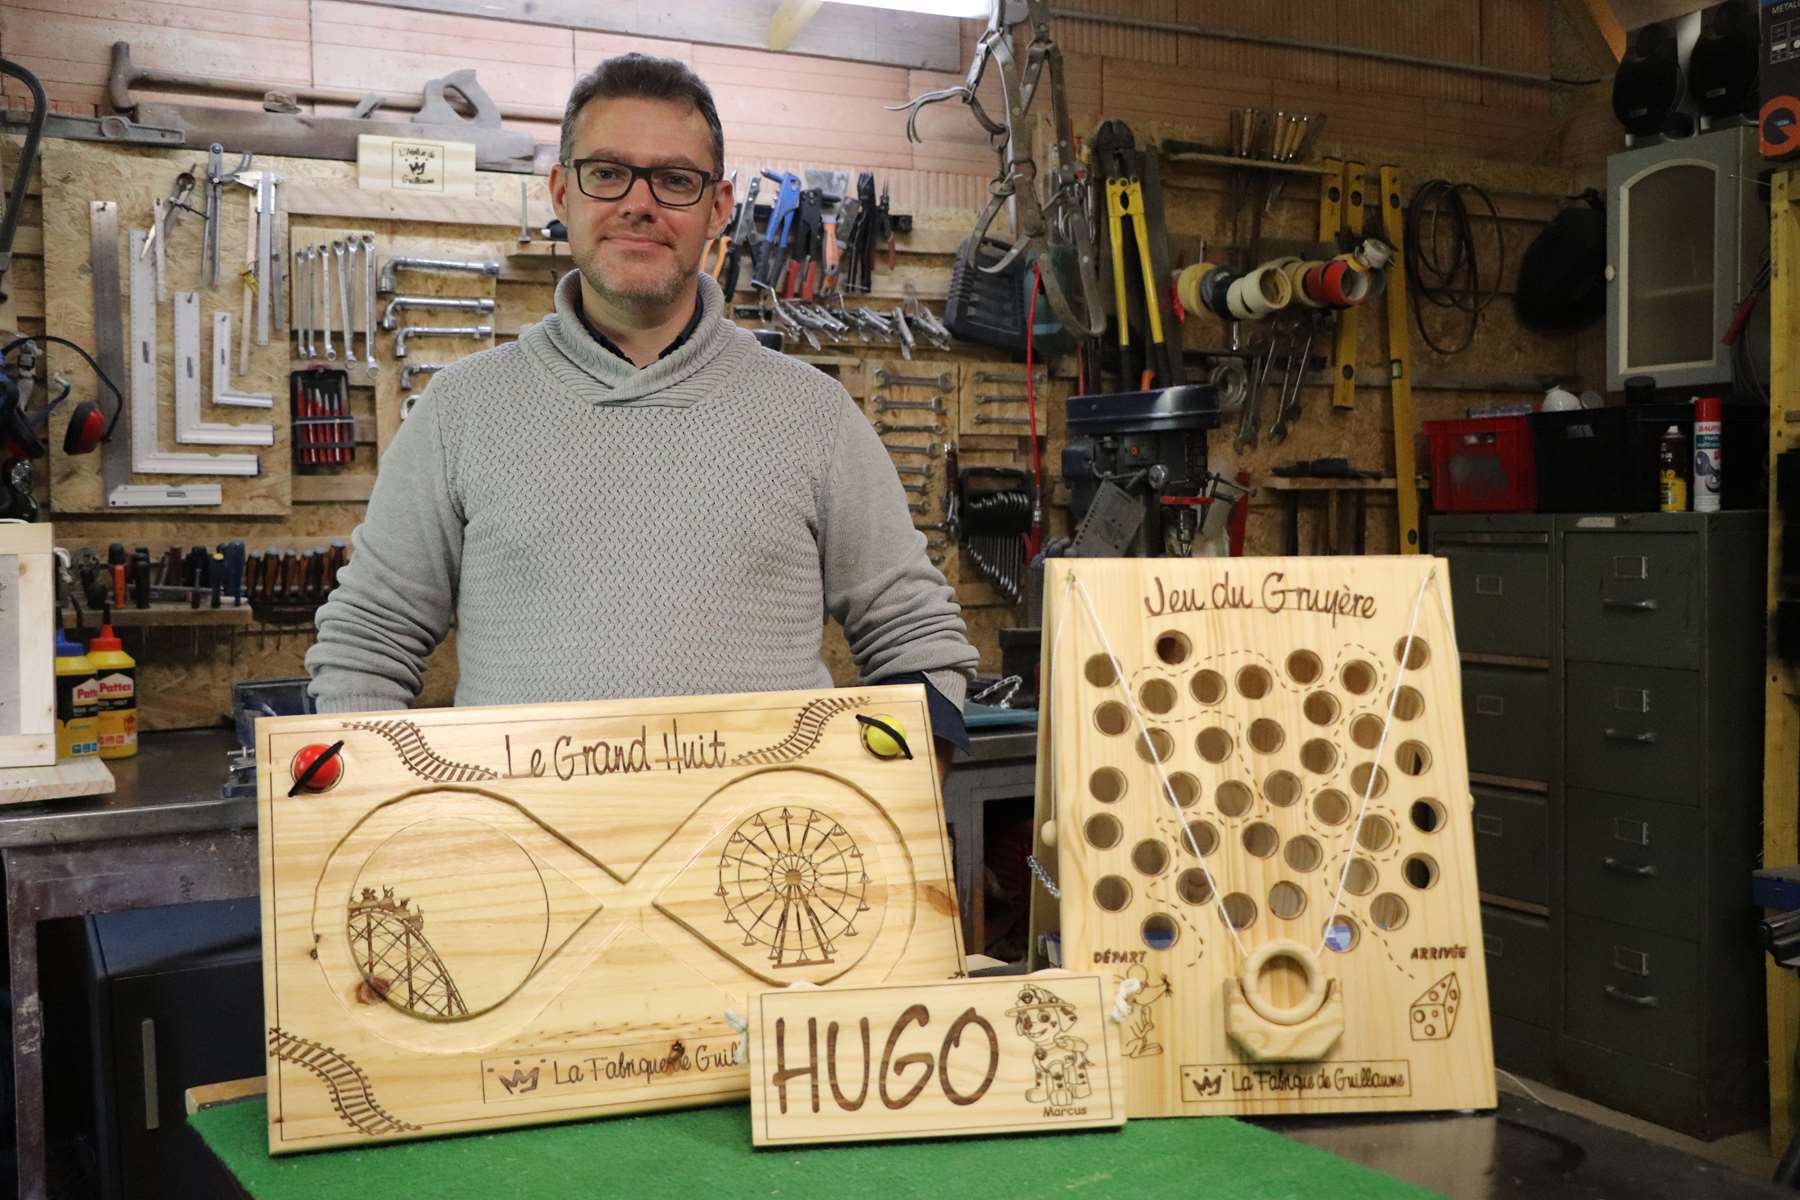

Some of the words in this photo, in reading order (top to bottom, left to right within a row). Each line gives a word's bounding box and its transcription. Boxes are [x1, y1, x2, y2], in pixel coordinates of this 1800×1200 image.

[1144, 576, 1205, 617] Jeu
[1212, 571, 1253, 609] du
[1261, 572, 1377, 628] Gruyère
[77, 688, 97, 699] Patt
[502, 734, 546, 779] Le
[554, 724, 650, 781] Grand
[655, 718, 726, 774] Huit
[1093, 948, 1147, 964] DÉPART
[1410, 944, 1467, 960] ARRIVÉE
[553, 1060, 583, 1085] La
[584, 1051, 667, 1084] Fabrique
[695, 1041, 740, 1071] Guil
[772, 1003, 999, 1114] HUGO
[1232, 1071, 1253, 1091] La
[1254, 1068, 1314, 1099] Fabrique
[1316, 1067, 1331, 1089] de
[1334, 1067, 1405, 1091] Guillaume
[1043, 1107, 1087, 1118] Marcus
